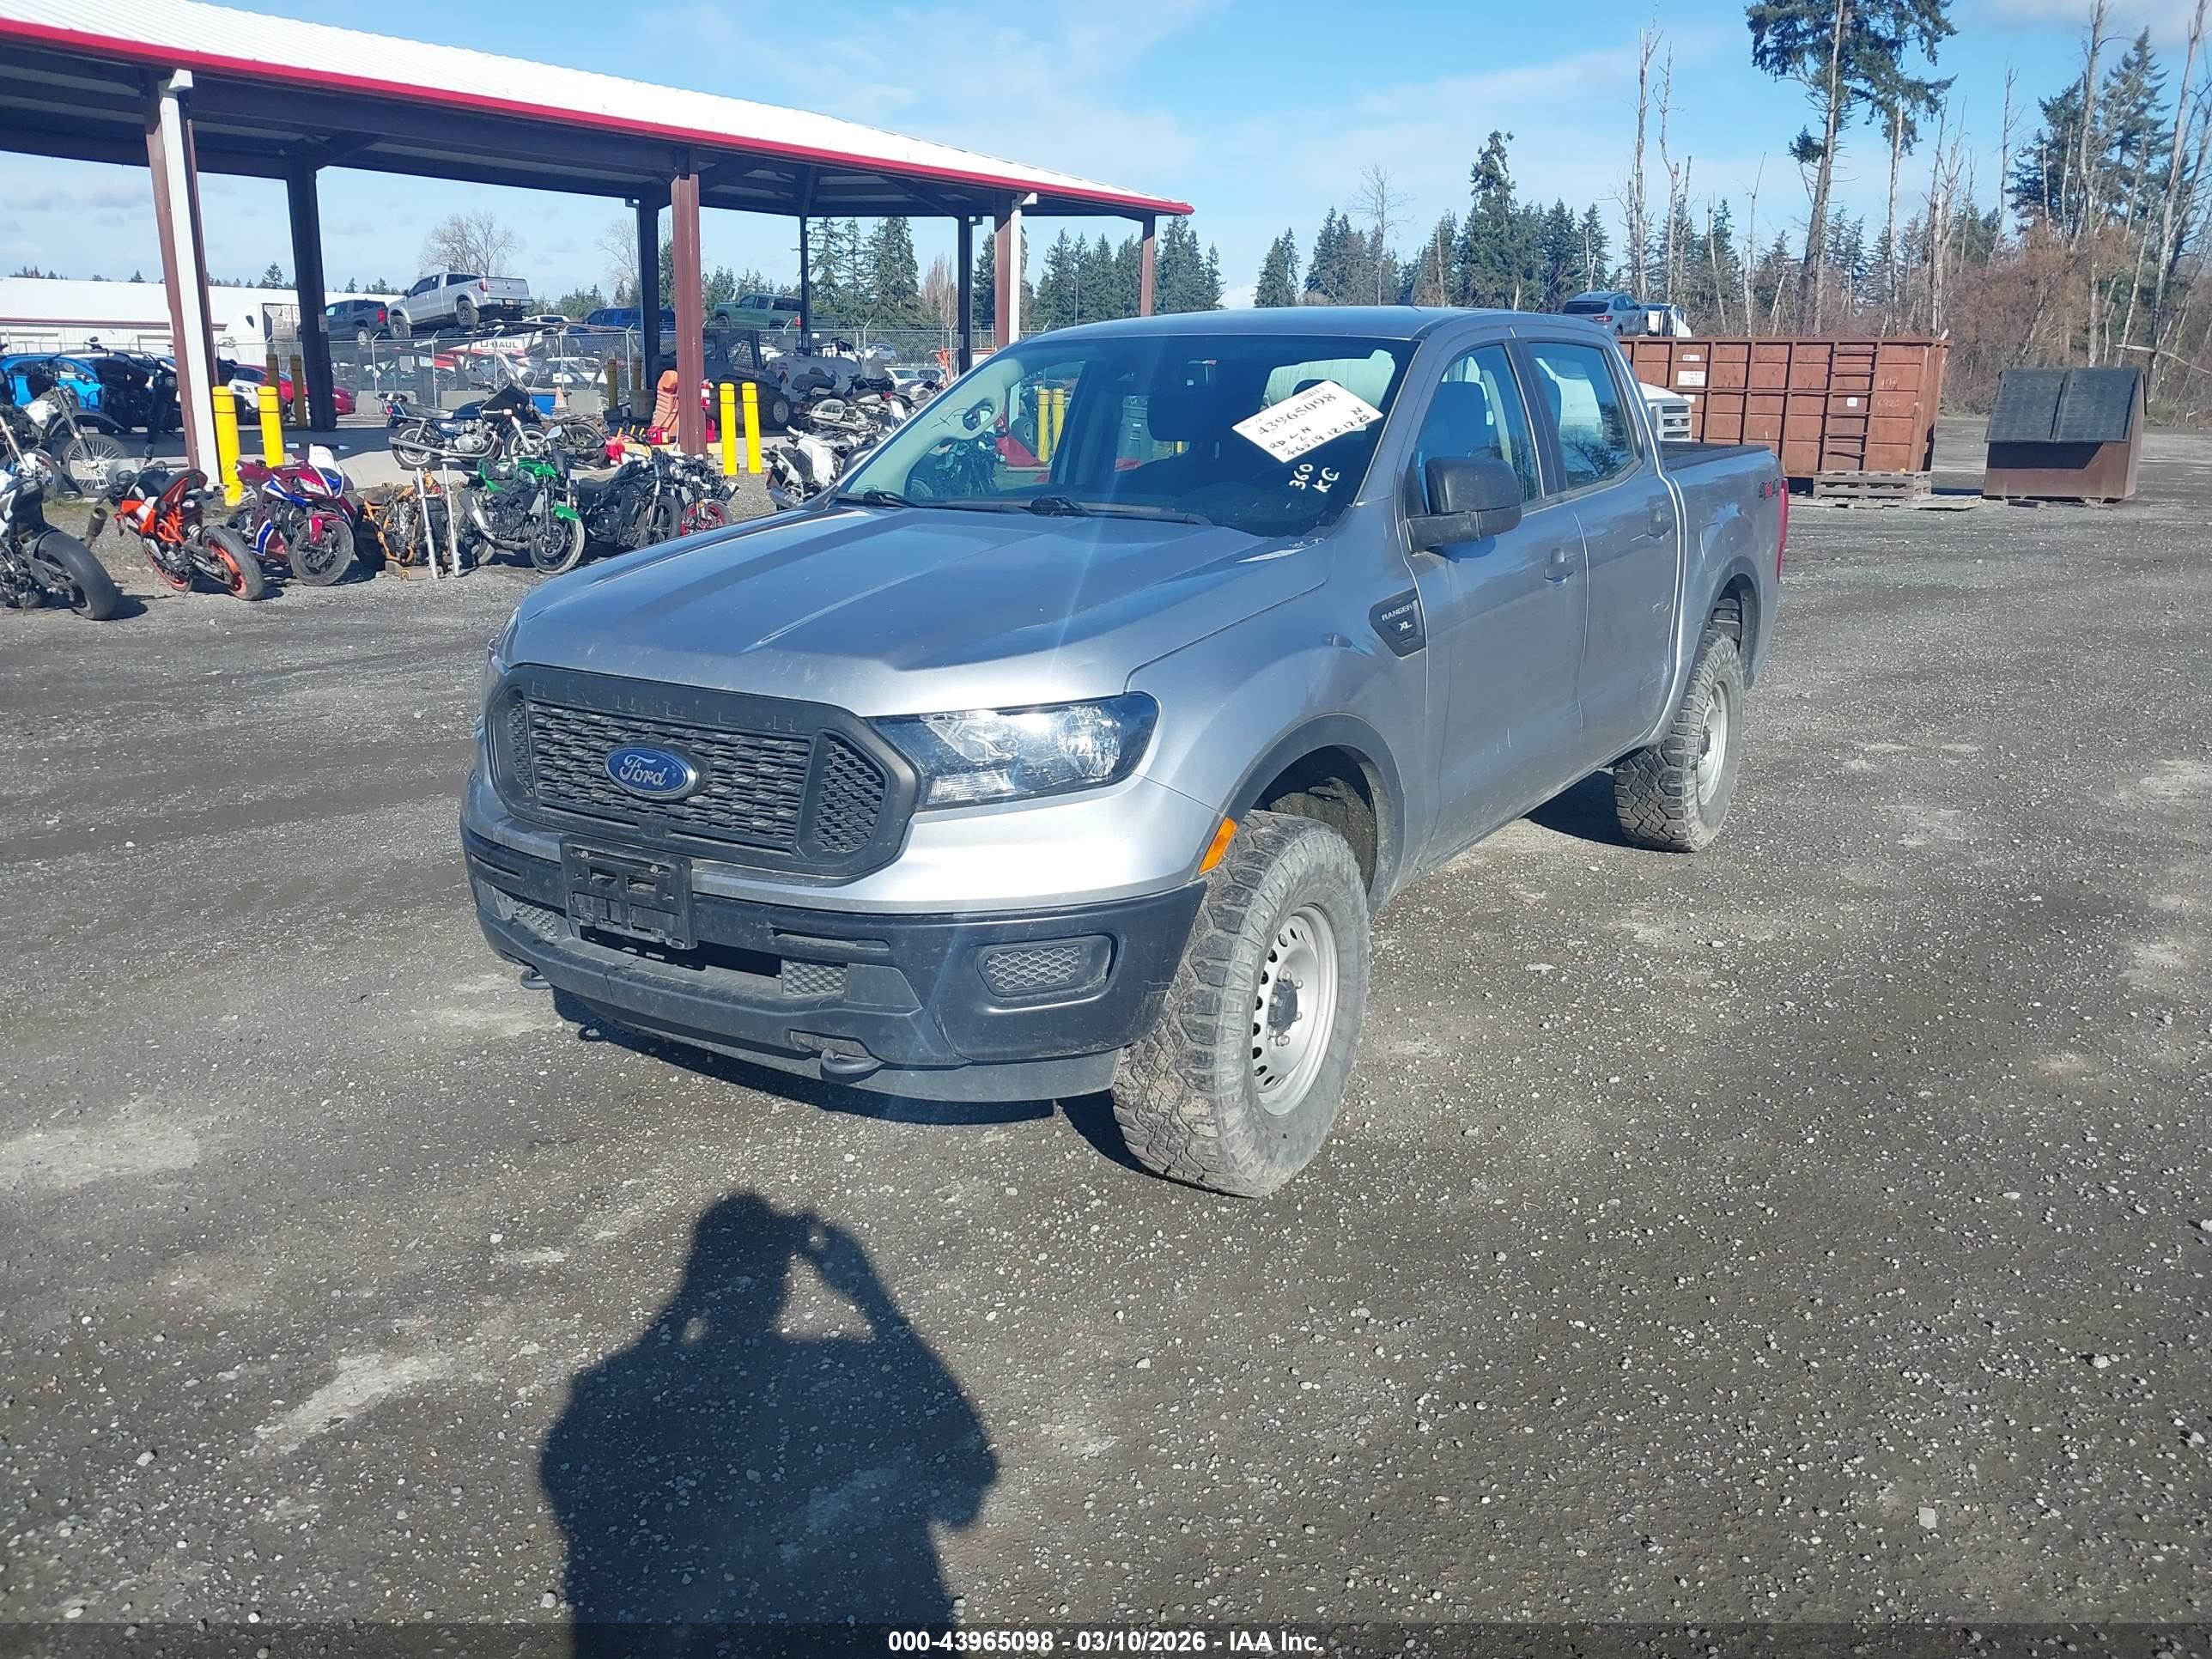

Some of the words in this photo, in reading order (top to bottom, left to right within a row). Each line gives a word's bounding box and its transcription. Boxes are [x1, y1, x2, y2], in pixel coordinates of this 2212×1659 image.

[1259, 393, 1337, 434] 43965098
[1312, 467, 1340, 493] KC
[1381, 604, 1413, 621] RANGER
[1398, 620, 1413, 631] XL
[618, 753, 668, 791] Ford
